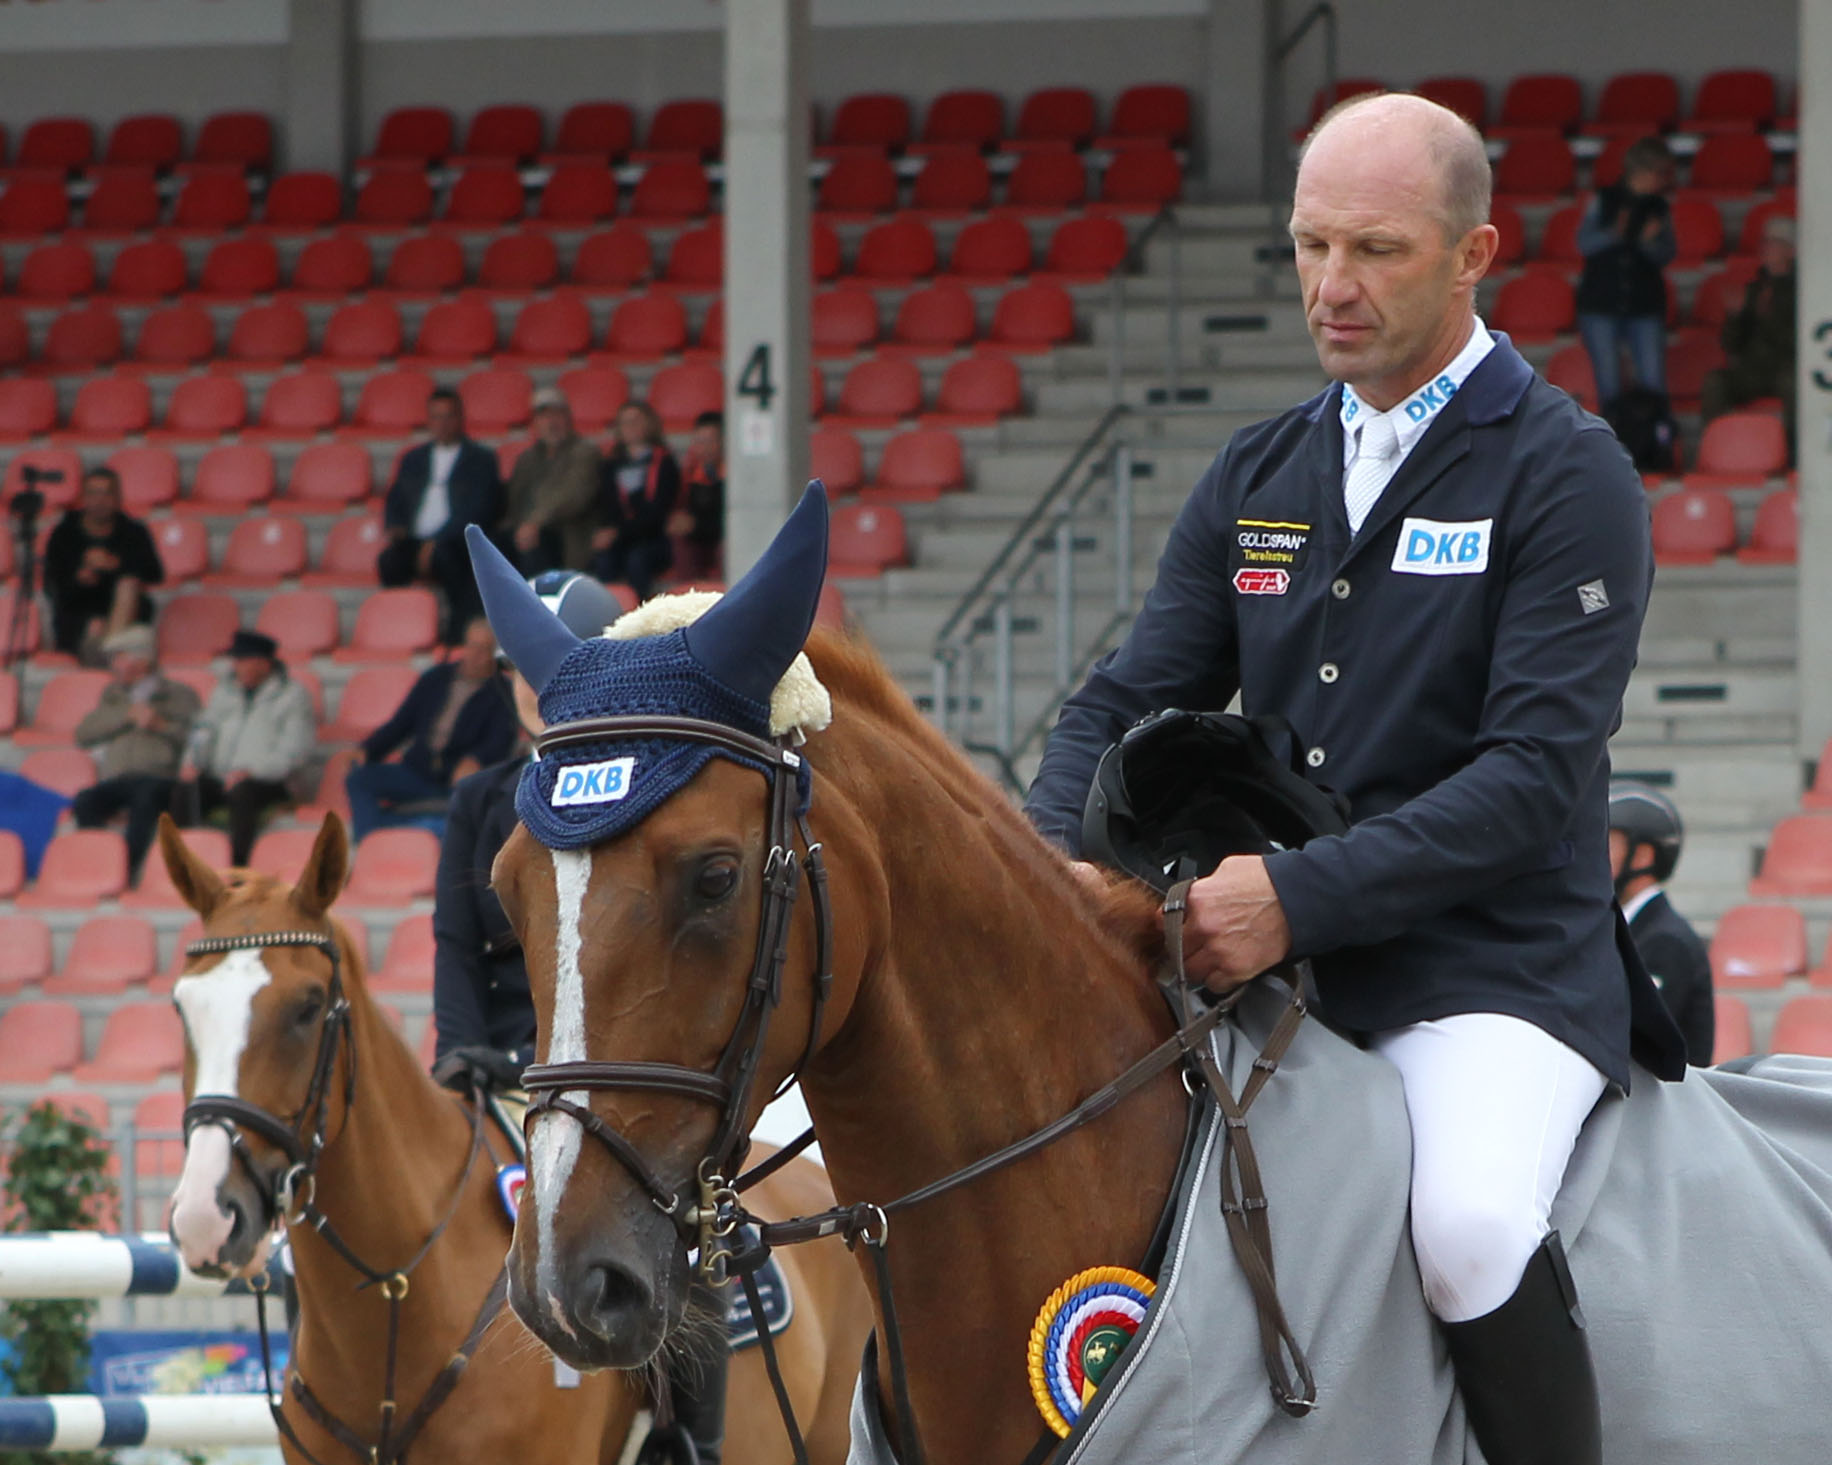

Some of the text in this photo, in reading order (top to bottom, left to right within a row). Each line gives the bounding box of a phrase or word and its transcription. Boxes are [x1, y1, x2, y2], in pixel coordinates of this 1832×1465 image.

[737, 342, 777, 411] 4
[1405, 374, 1458, 423] DKB
[1405, 529, 1481, 564] DKB
[559, 765, 623, 799] DKB
